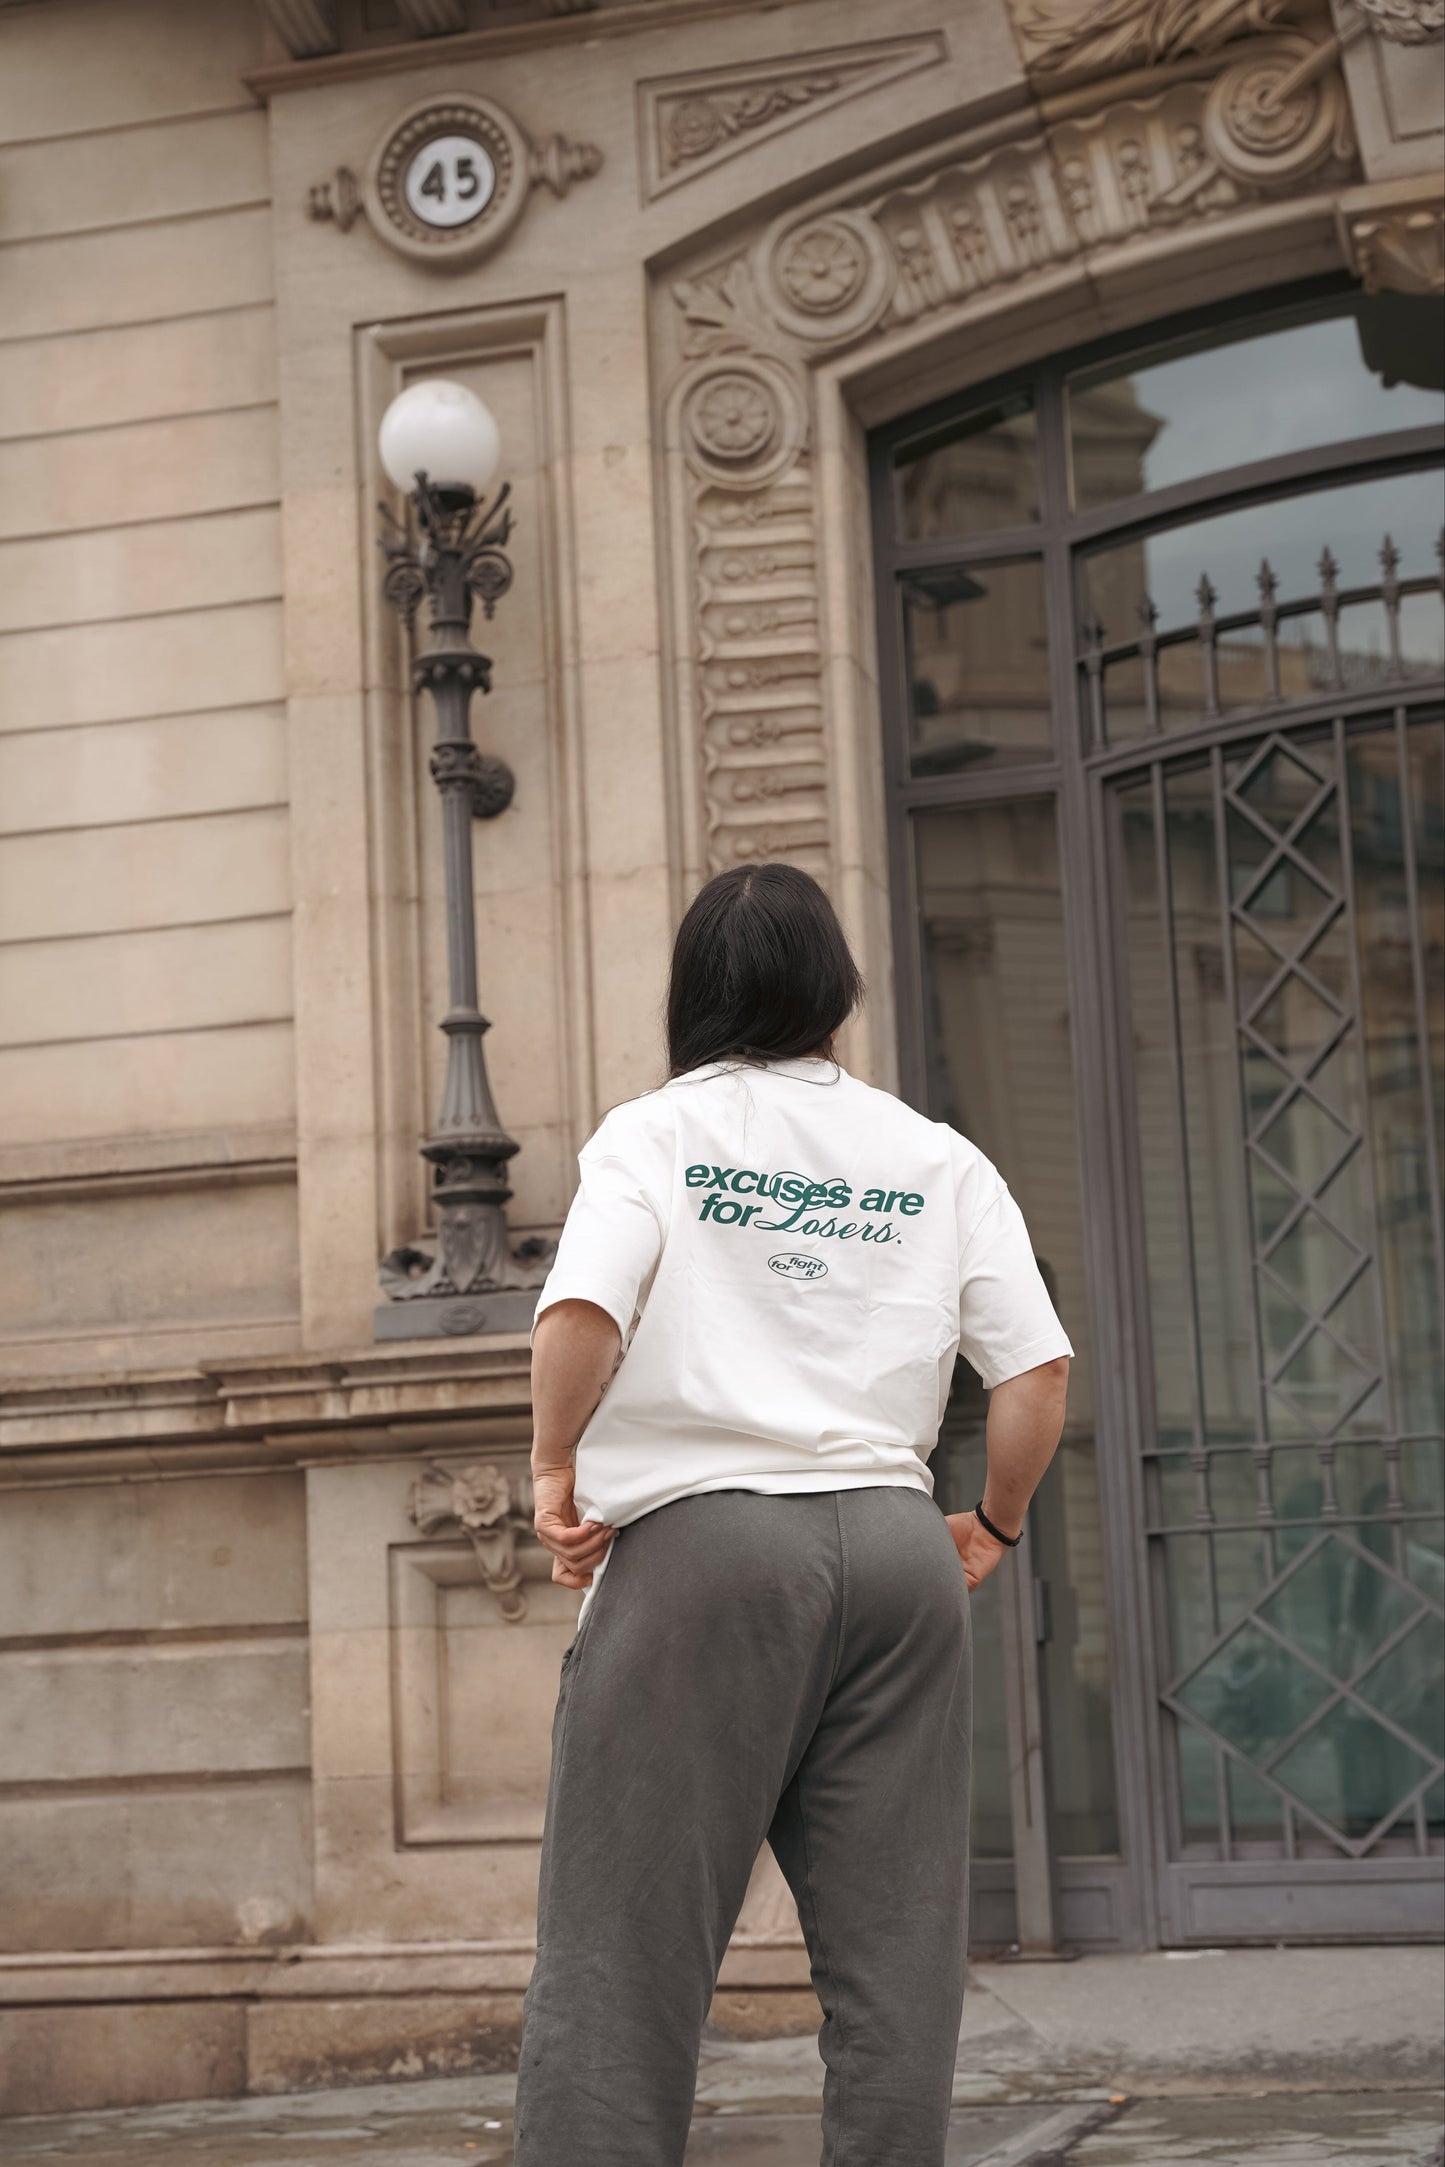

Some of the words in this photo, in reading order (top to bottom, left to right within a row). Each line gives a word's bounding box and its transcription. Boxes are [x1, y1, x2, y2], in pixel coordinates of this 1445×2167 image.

[420, 157, 479, 203] 45
[685, 1164, 853, 1208] excuses
[859, 1188, 924, 1215] are
[698, 1193, 762, 1226] for
[753, 1171, 902, 1244] Losers.
[771, 1260, 793, 1271] for
[805, 1268, 815, 1277] it
[789, 1257, 823, 1271] fight
